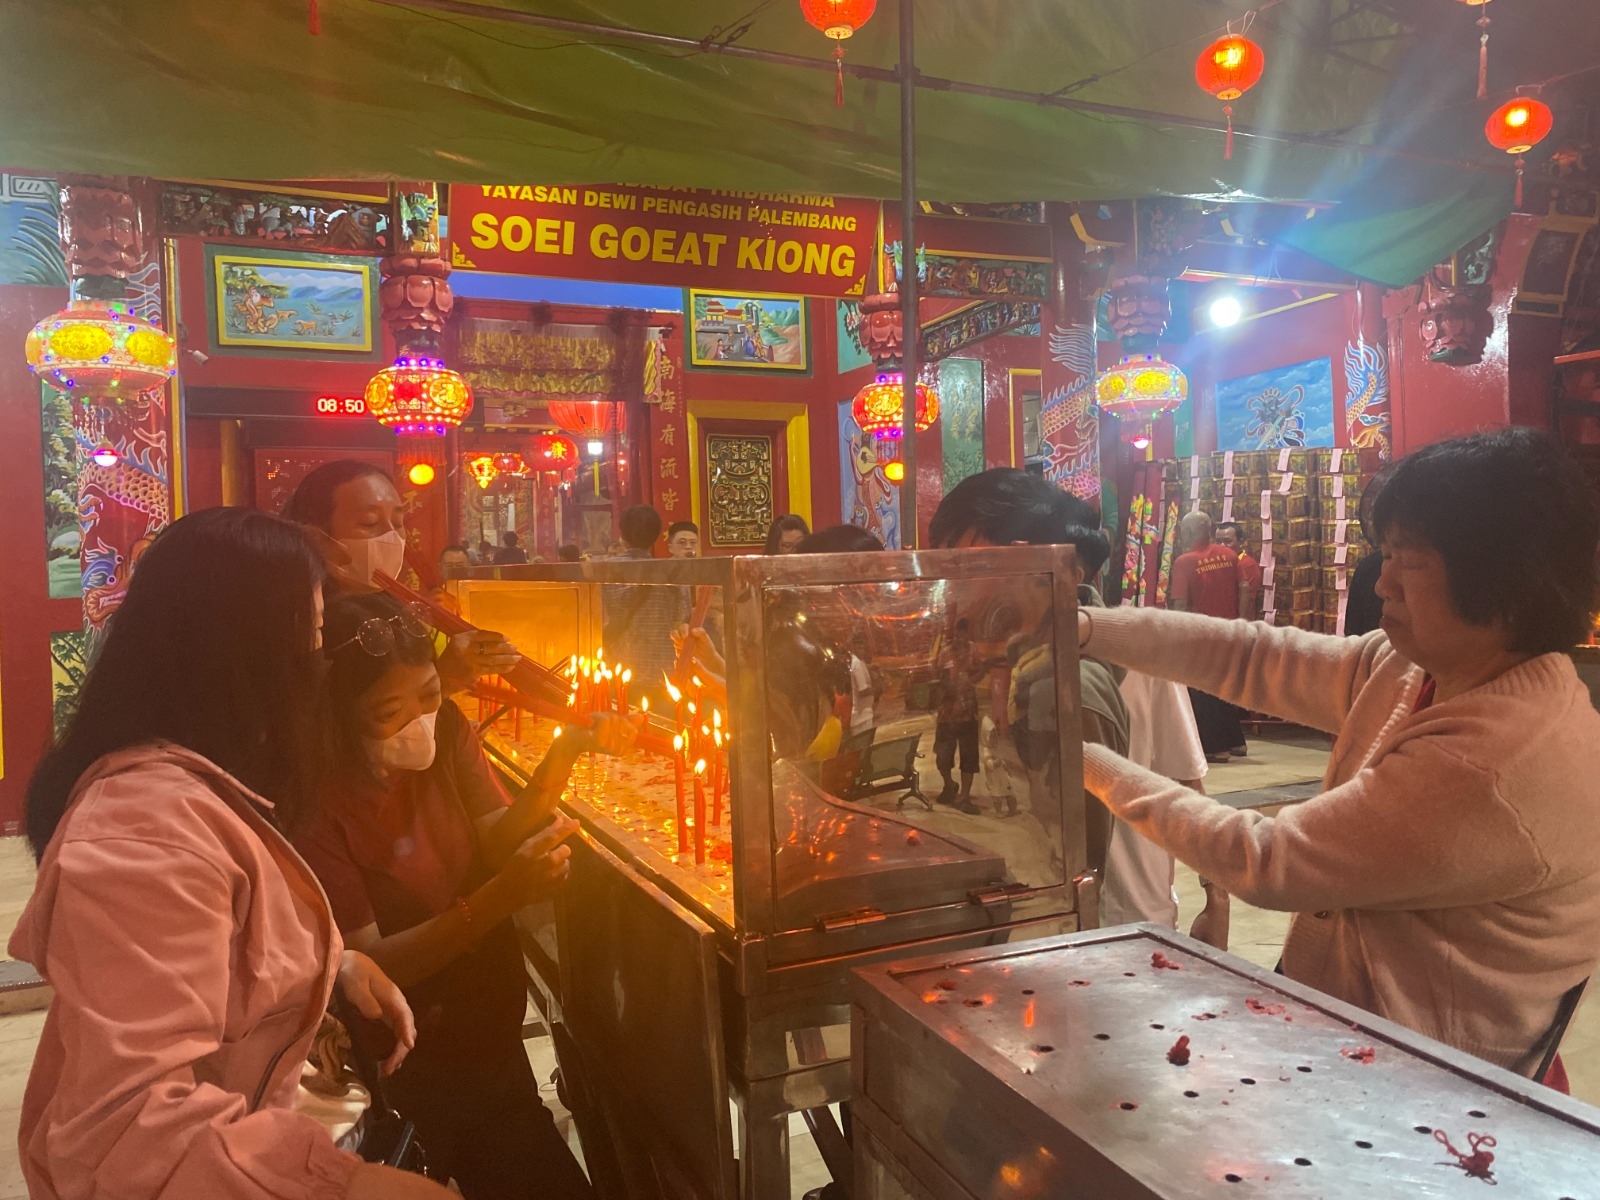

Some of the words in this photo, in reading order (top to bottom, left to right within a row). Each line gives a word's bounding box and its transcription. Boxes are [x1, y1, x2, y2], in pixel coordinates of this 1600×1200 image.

[481, 185, 577, 205] YAYASAN
[583, 190, 637, 211] DEWI
[642, 196, 742, 220] PENGASIH
[747, 206, 857, 232] PALEMBANG
[470, 212, 575, 255] SOEI
[589, 223, 727, 267] GOEAT
[736, 236, 857, 278] KIONG
[317, 398, 364, 413] 08:50
